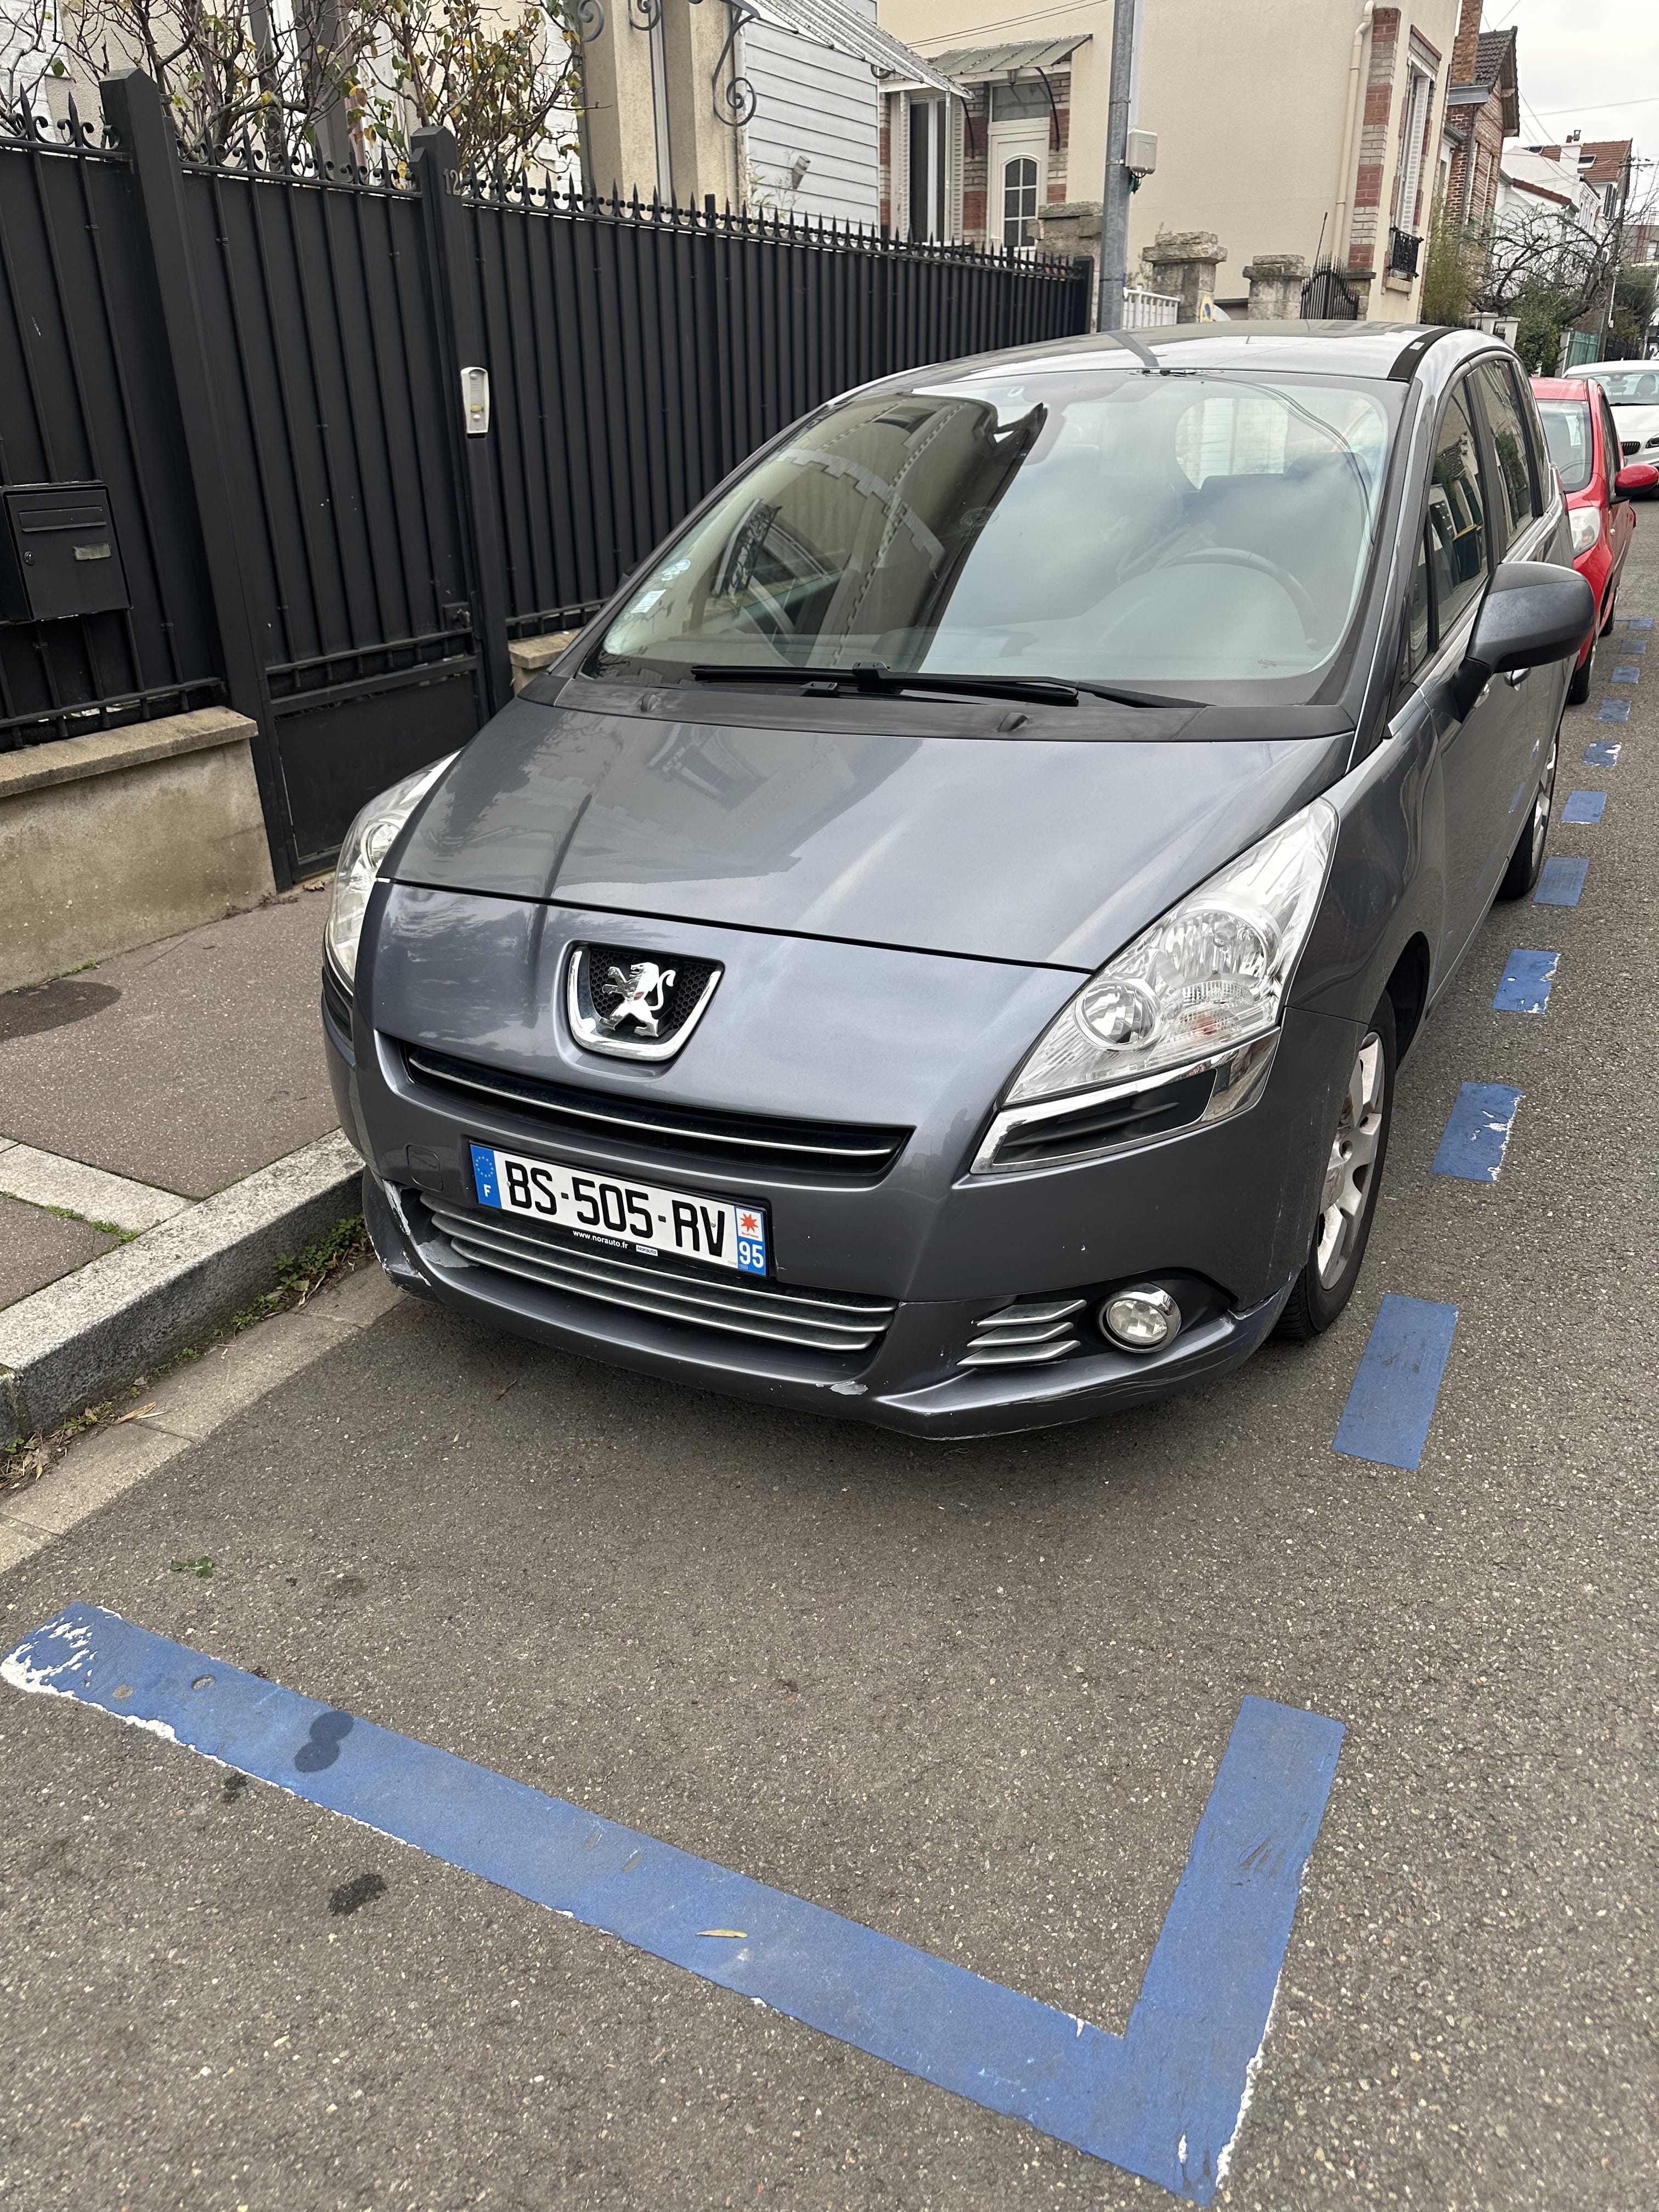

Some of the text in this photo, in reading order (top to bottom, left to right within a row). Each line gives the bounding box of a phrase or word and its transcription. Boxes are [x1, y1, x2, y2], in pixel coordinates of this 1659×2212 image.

[443, 168, 461, 196] 12
[483, 1183, 492, 1197] F
[505, 1160, 725, 1257] BS-505-RV
[572, 1230, 628, 1249] www.norauto.fr
[739, 1241, 764, 1268] 95
